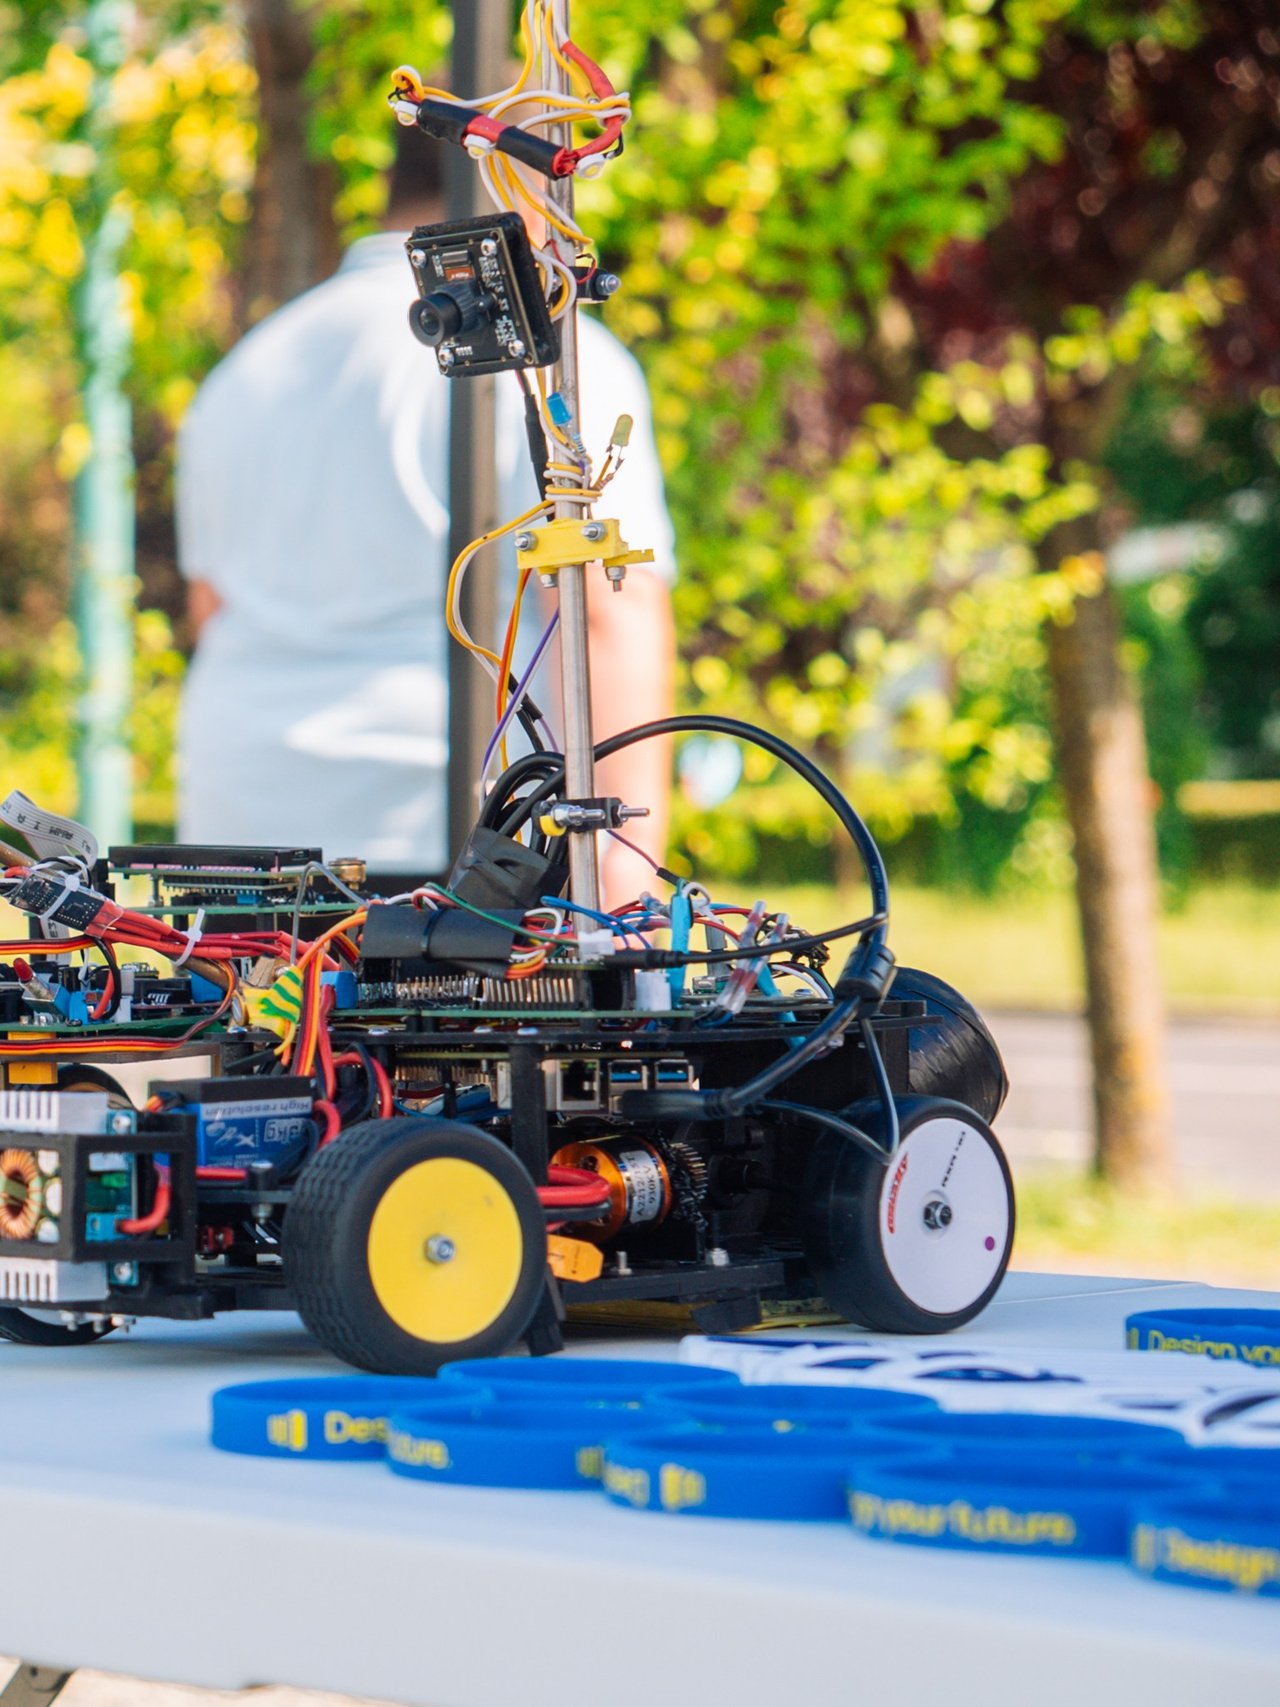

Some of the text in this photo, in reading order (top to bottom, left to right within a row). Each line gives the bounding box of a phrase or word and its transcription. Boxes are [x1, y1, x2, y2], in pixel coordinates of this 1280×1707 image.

[205, 1100, 309, 1116] High resolution
[324, 1410, 388, 1444] Des
